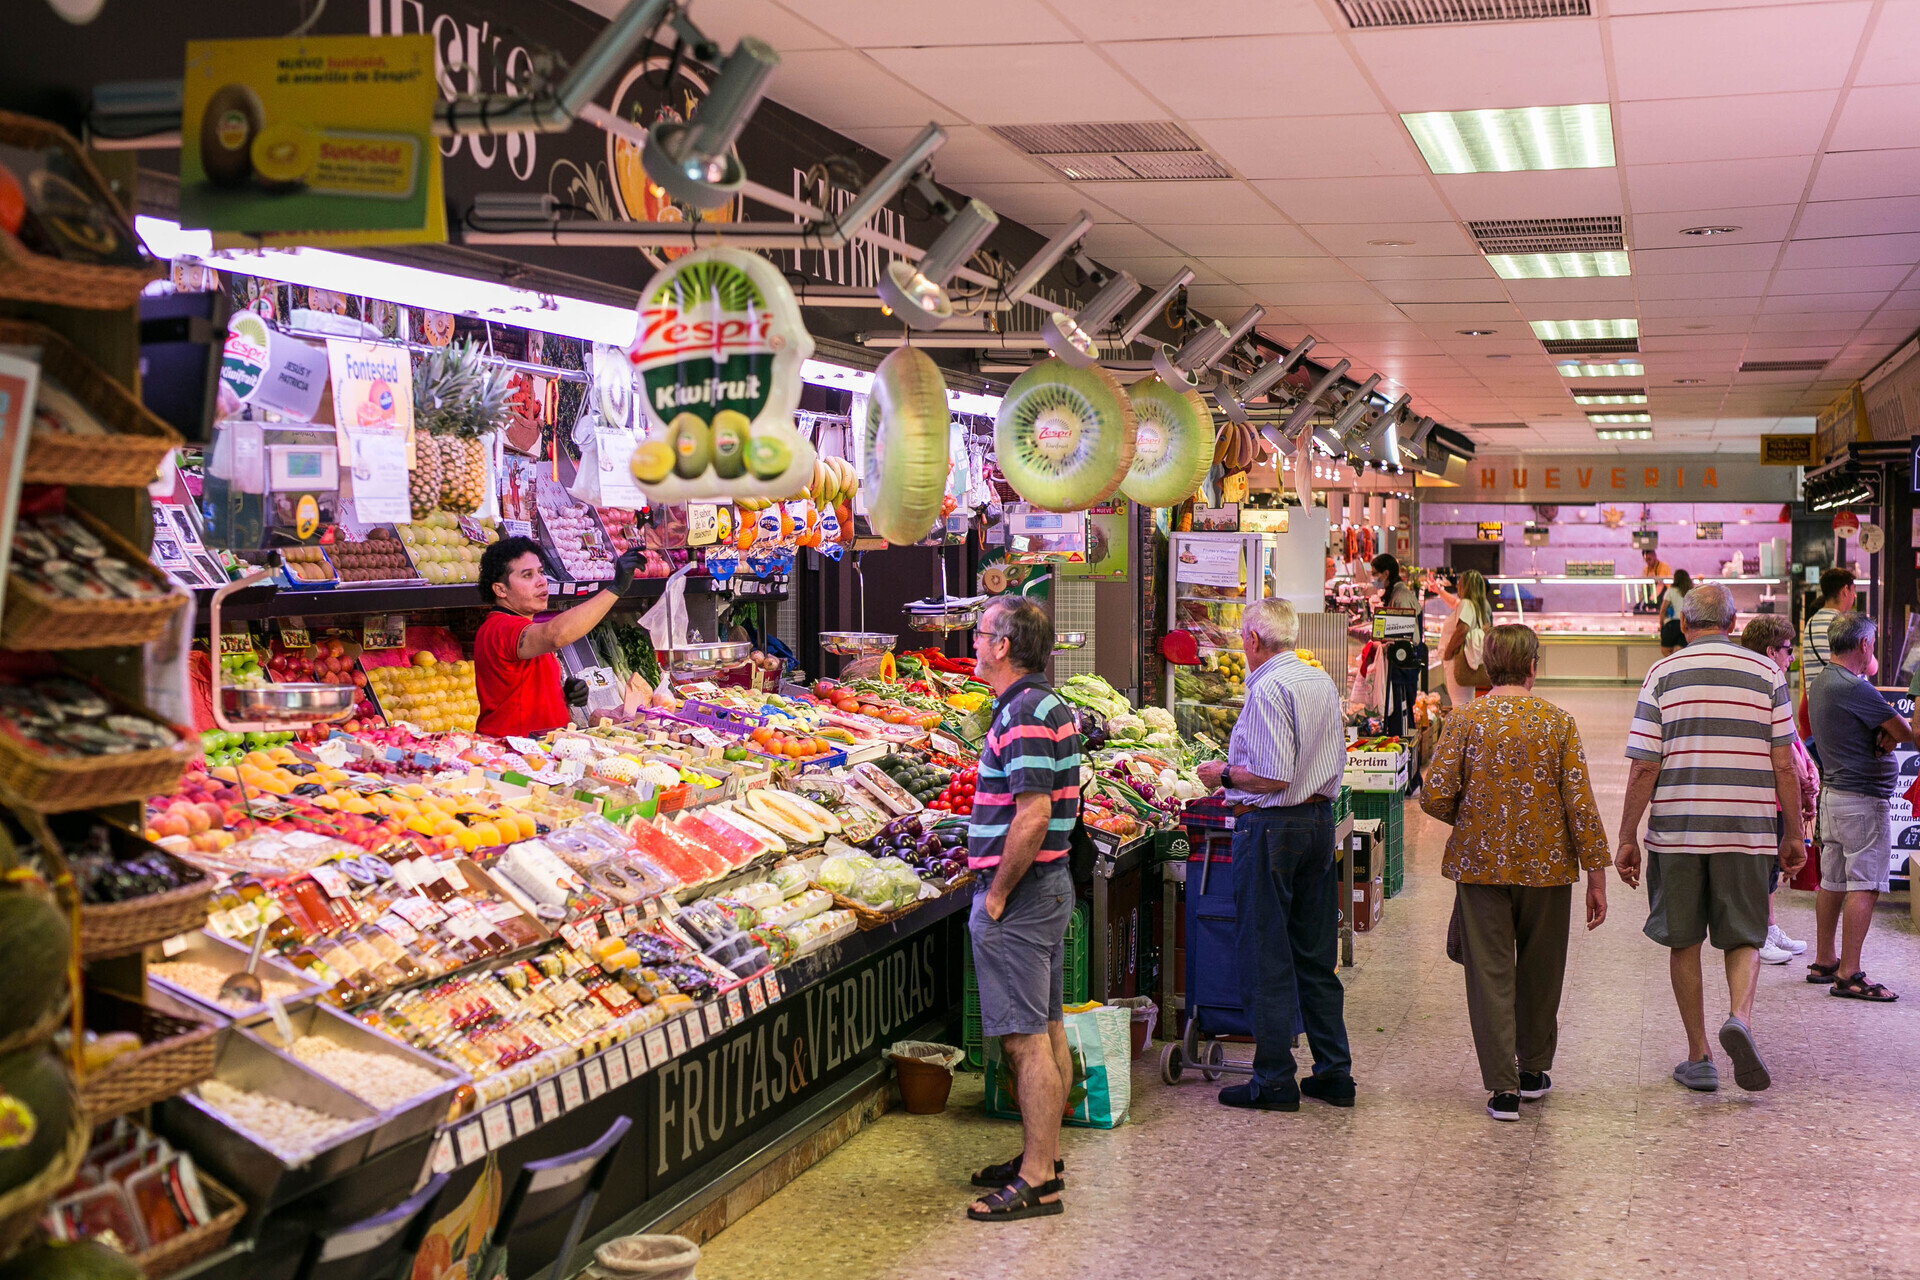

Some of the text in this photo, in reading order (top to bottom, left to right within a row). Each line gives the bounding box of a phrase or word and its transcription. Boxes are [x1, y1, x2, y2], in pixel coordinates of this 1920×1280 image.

[630, 308, 774, 366] Zespri
[345, 353, 399, 384] Fontestad
[655, 374, 762, 410] Kiwifruit
[1038, 427, 1073, 441] Zespri
[1481, 467, 1719, 489] HUEVERIA
[1349, 756, 1388, 767] Perlim
[656, 1011, 789, 1178] FRUTAS
[805, 932, 935, 1081] VERDURAS
